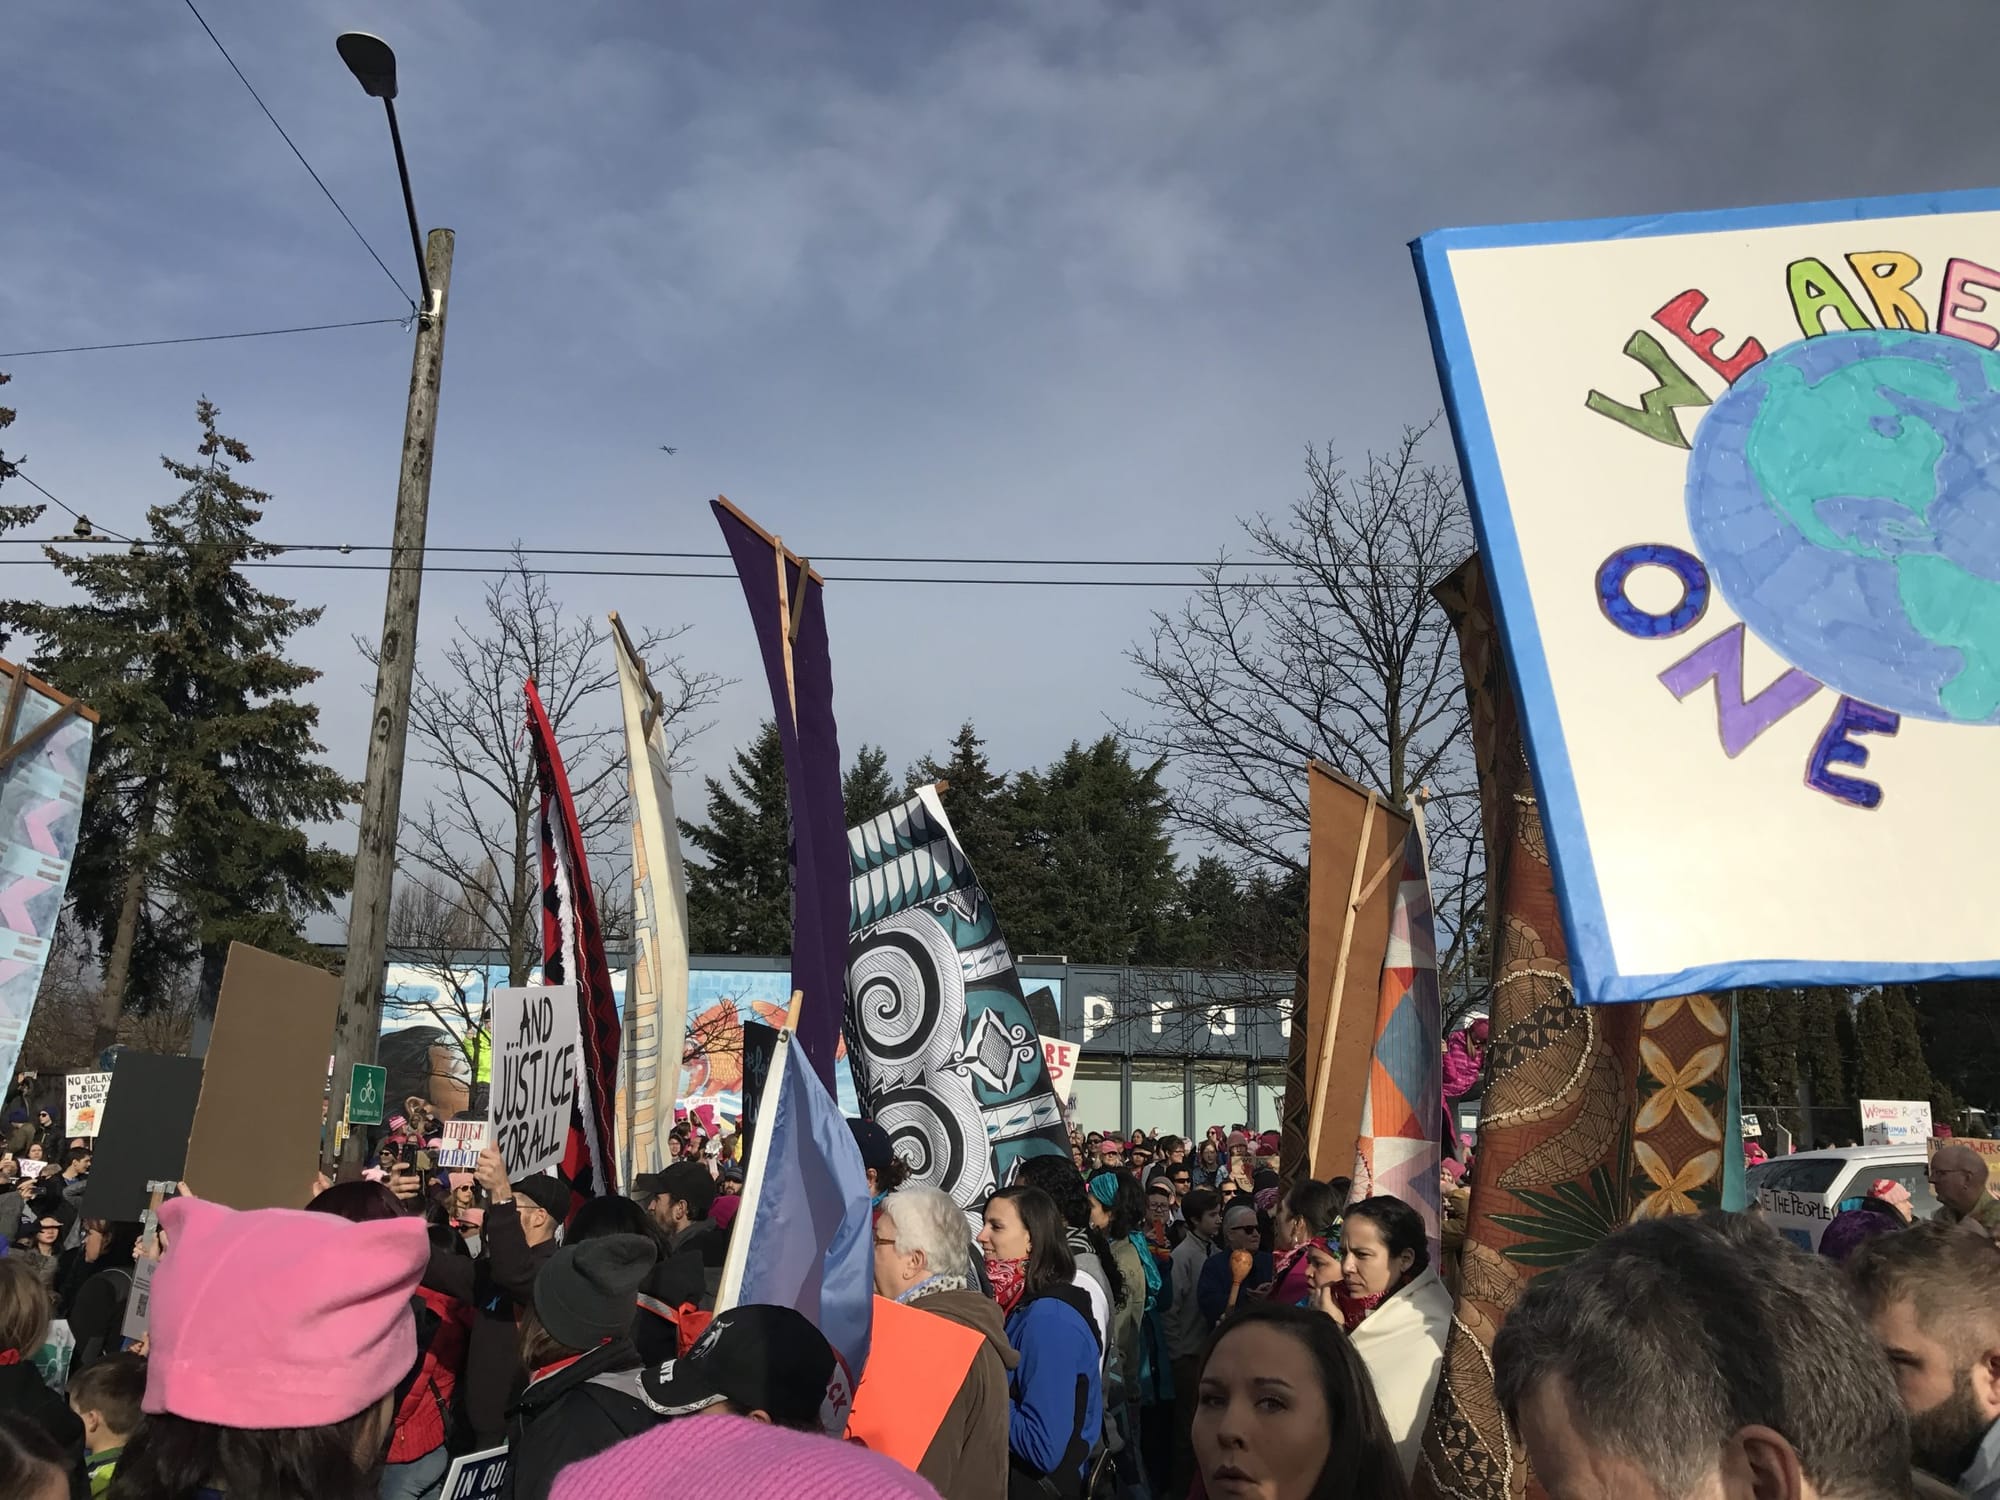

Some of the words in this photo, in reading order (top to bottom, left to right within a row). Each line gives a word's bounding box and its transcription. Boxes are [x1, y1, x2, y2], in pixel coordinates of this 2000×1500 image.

[1585, 288, 1768, 450] WE
[1786, 250, 2000, 352] ARE
[1595, 542, 1901, 812] ONE
[67, 1076, 81, 1086] NO
[494, 1043, 575, 1126] JUSTICE
[81, 1084, 106, 1094] BIGLY
[70, 1093, 103, 1102] ENOUGH
[68, 1101, 91, 1111] YOUR
[1881, 1121, 1908, 1136] HUMAN
[457, 1139, 472, 1151] IS
[1770, 1189, 1791, 1214] THE
[1788, 1192, 1832, 1221] PEOPLE
[453, 1468, 480, 1500] IN
[480, 1459, 508, 1492] OU
